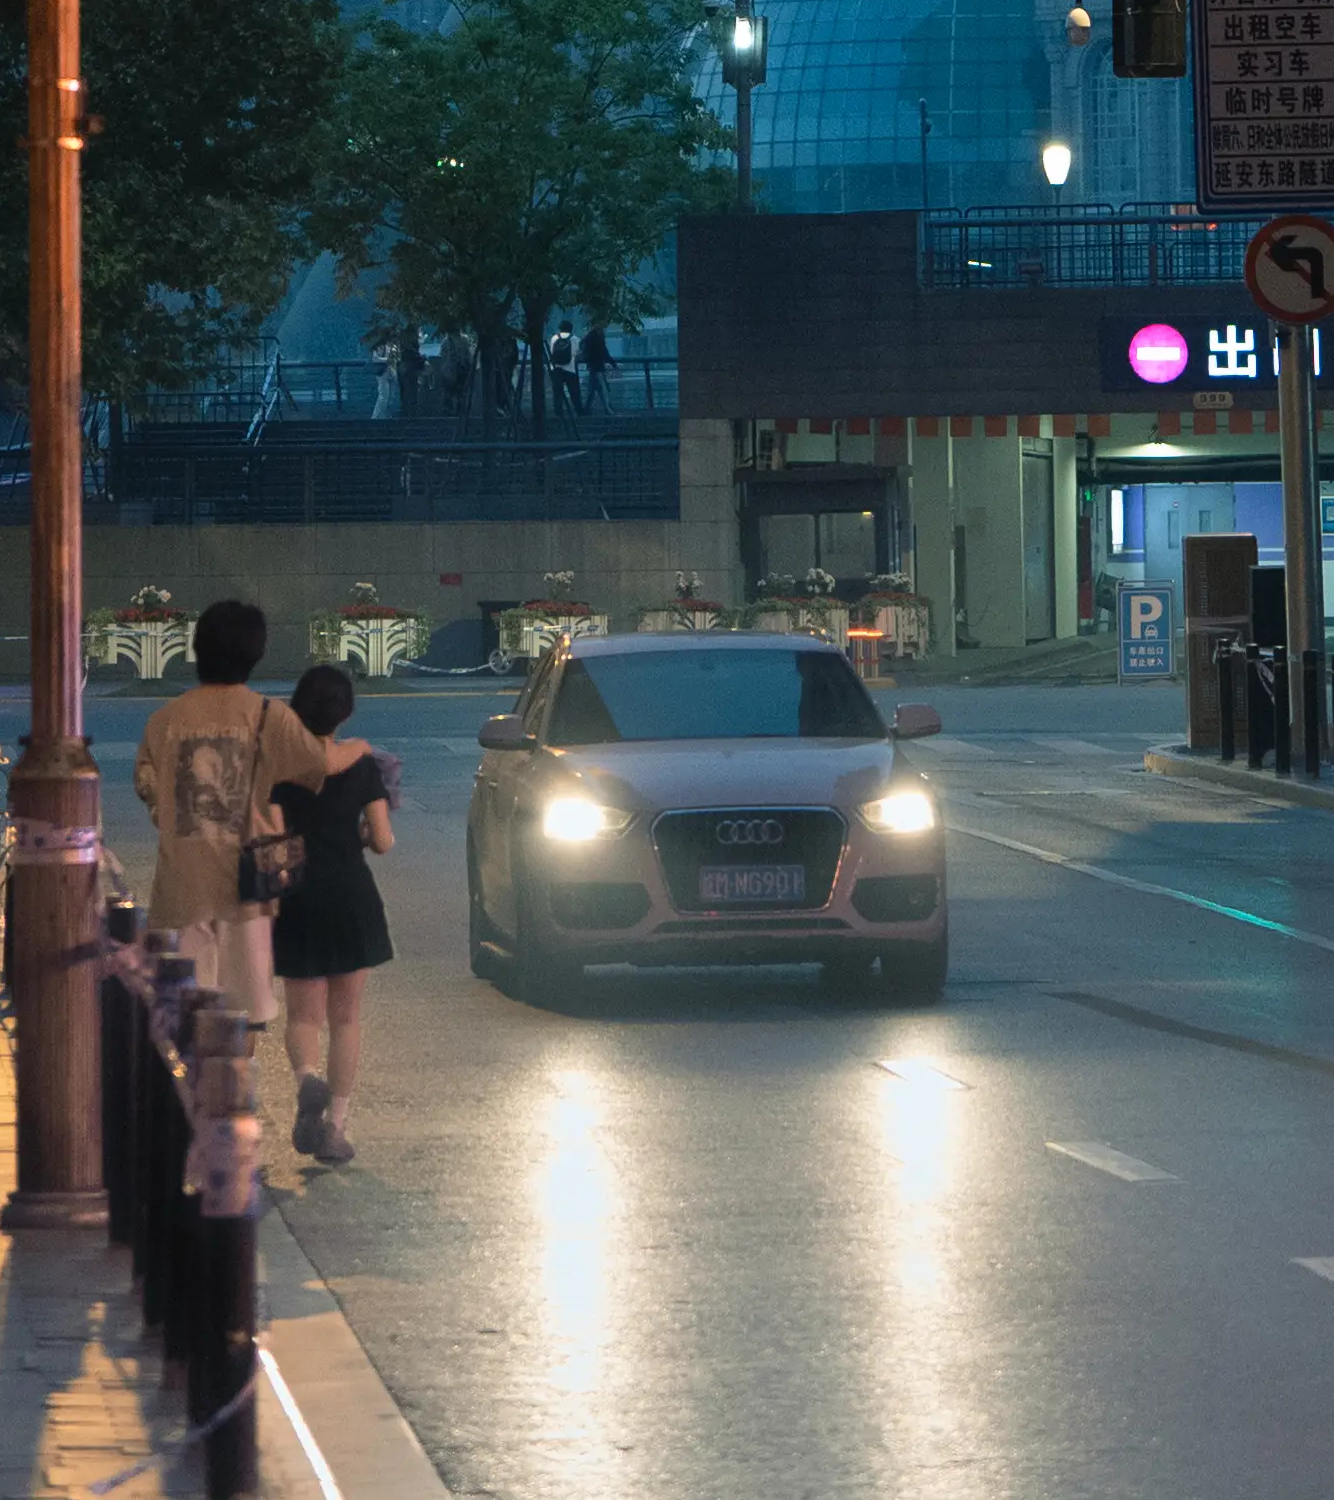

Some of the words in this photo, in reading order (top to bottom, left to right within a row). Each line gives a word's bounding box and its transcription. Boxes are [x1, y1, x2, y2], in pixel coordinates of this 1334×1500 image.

[1224, 12, 1322, 41] 出租空车
[1237, 49, 1310, 77] 实习车
[1225, 86, 1324, 115] 临时号牌
[1130, 595, 1163, 639] P
